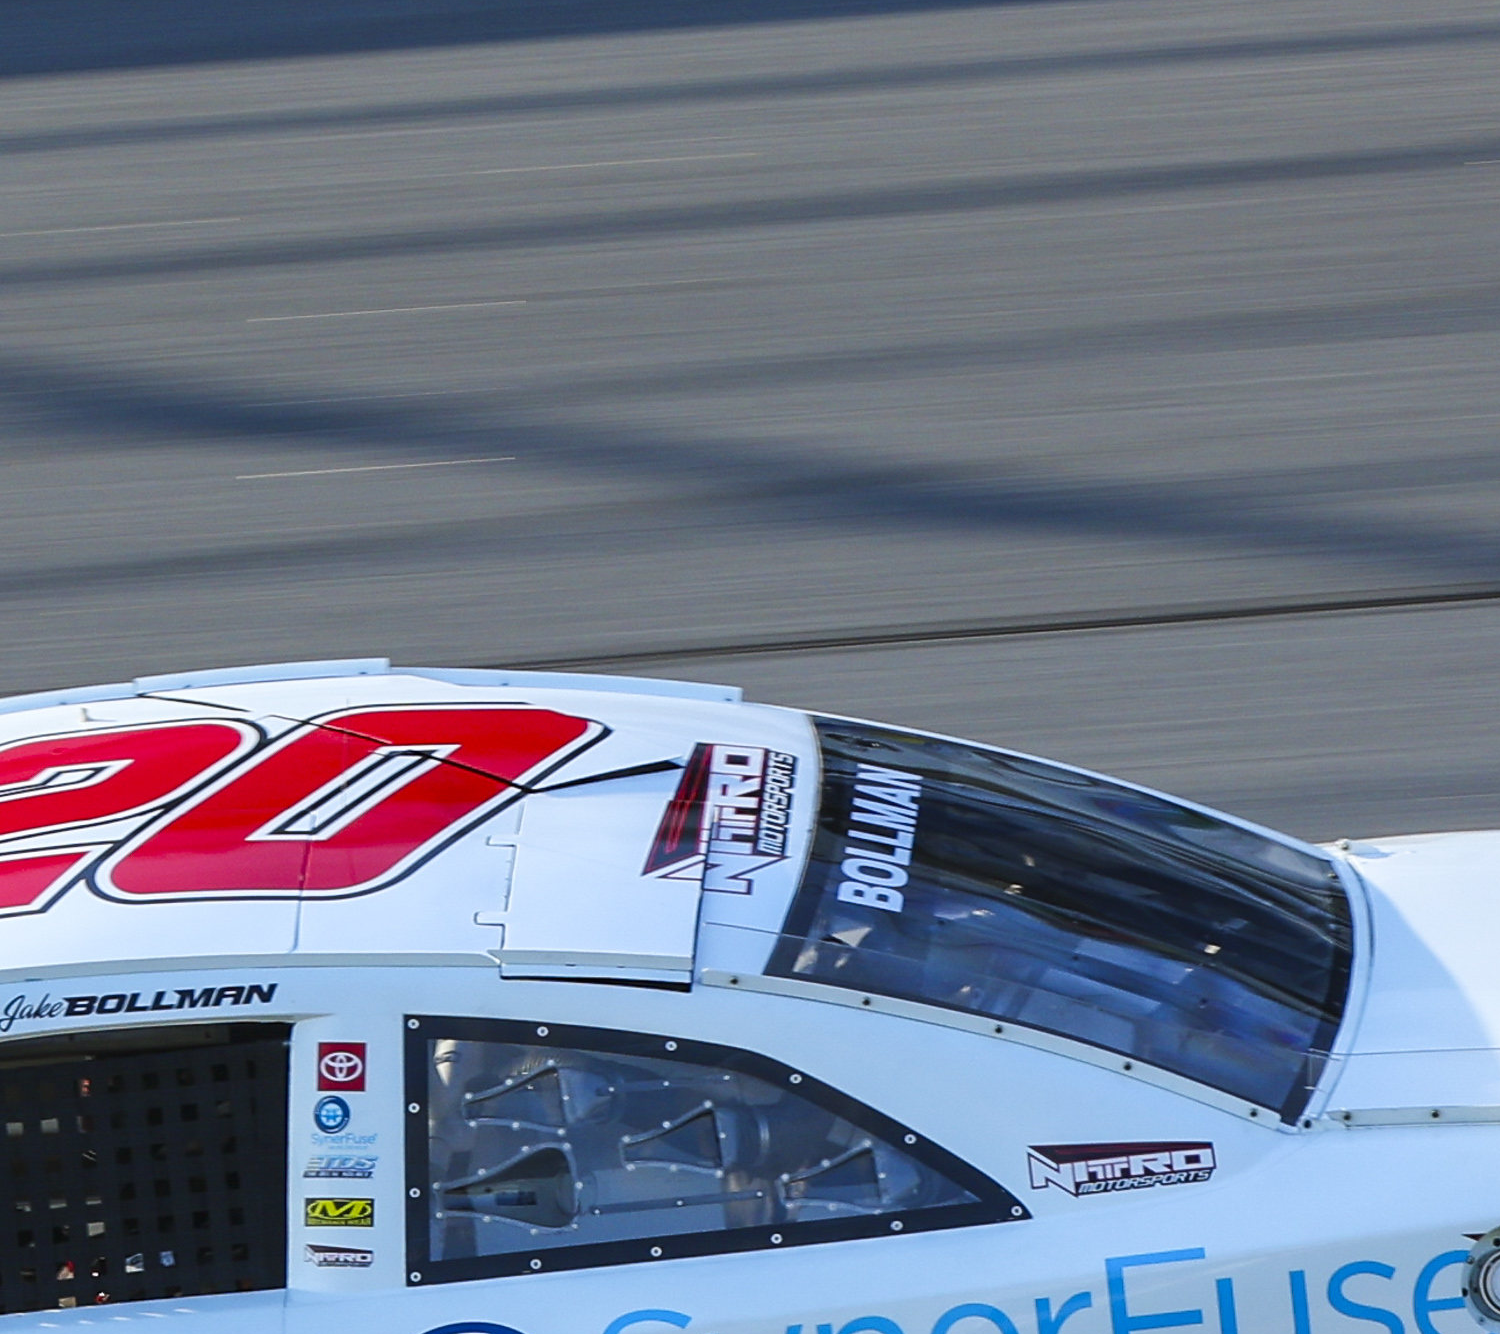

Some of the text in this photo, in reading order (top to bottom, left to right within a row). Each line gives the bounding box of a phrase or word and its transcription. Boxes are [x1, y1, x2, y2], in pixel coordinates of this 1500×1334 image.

[650, 744, 790, 895] NITRO
[758, 751, 797, 854] MOTORSPORTS
[836, 763, 923, 913] BOLLMAN
[63, 983, 278, 1017] BOLLMAN
[1028, 1146, 1216, 1197] NITRO
[1078, 1169, 1210, 1193] MOTORSPORTS
